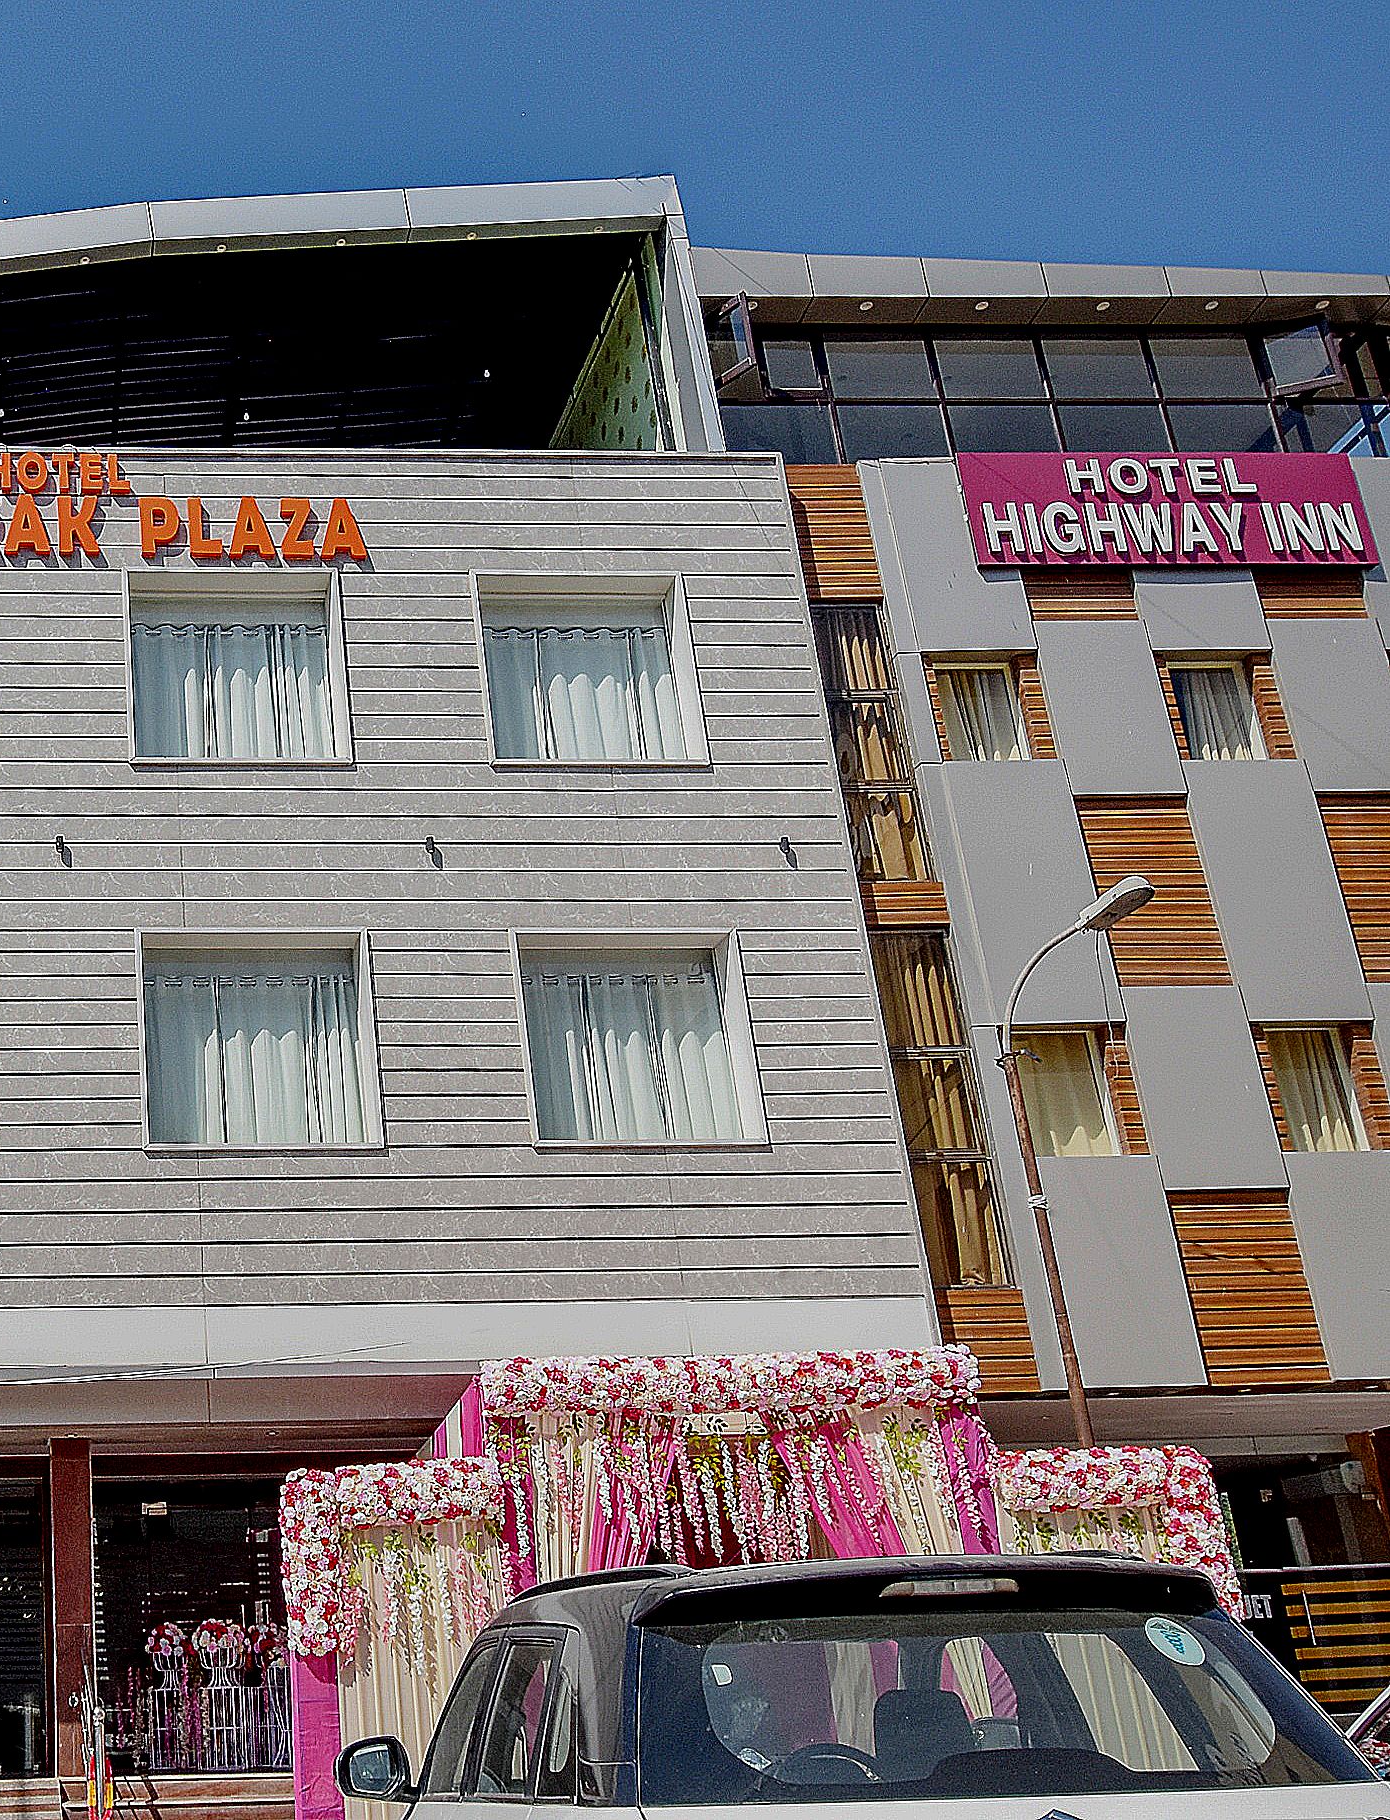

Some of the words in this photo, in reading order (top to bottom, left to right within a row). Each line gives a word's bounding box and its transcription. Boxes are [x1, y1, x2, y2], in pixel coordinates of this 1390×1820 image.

[1063, 458, 1259, 495] HOTEL
[139, 497, 367, 560] PLAZA
[981, 501, 1244, 556] HIGHWAY
[1261, 501, 1366, 553] INN
